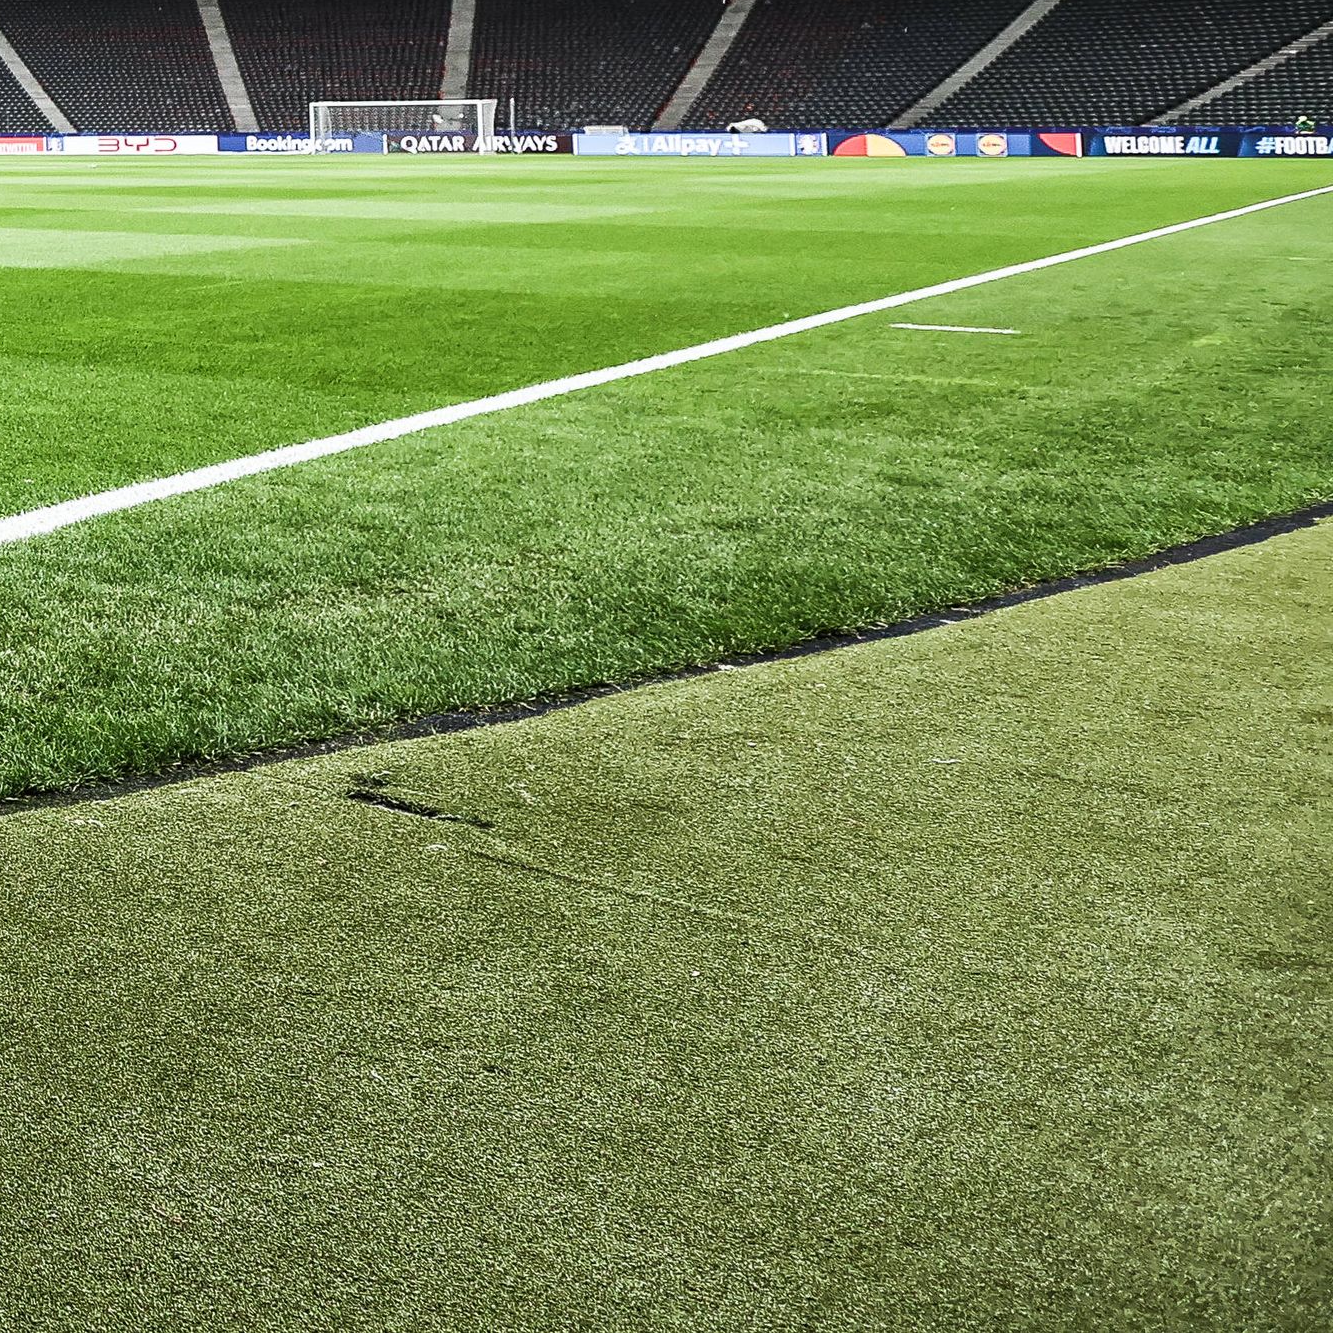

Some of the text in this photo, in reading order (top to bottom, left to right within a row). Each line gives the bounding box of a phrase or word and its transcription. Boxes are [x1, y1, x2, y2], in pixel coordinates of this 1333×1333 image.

[98, 138, 177, 152] BYD
[246, 135, 353, 153] Bookingcom
[401, 135, 465, 154] QATAR
[1104, 136, 1220, 154] WELCOME ALL
